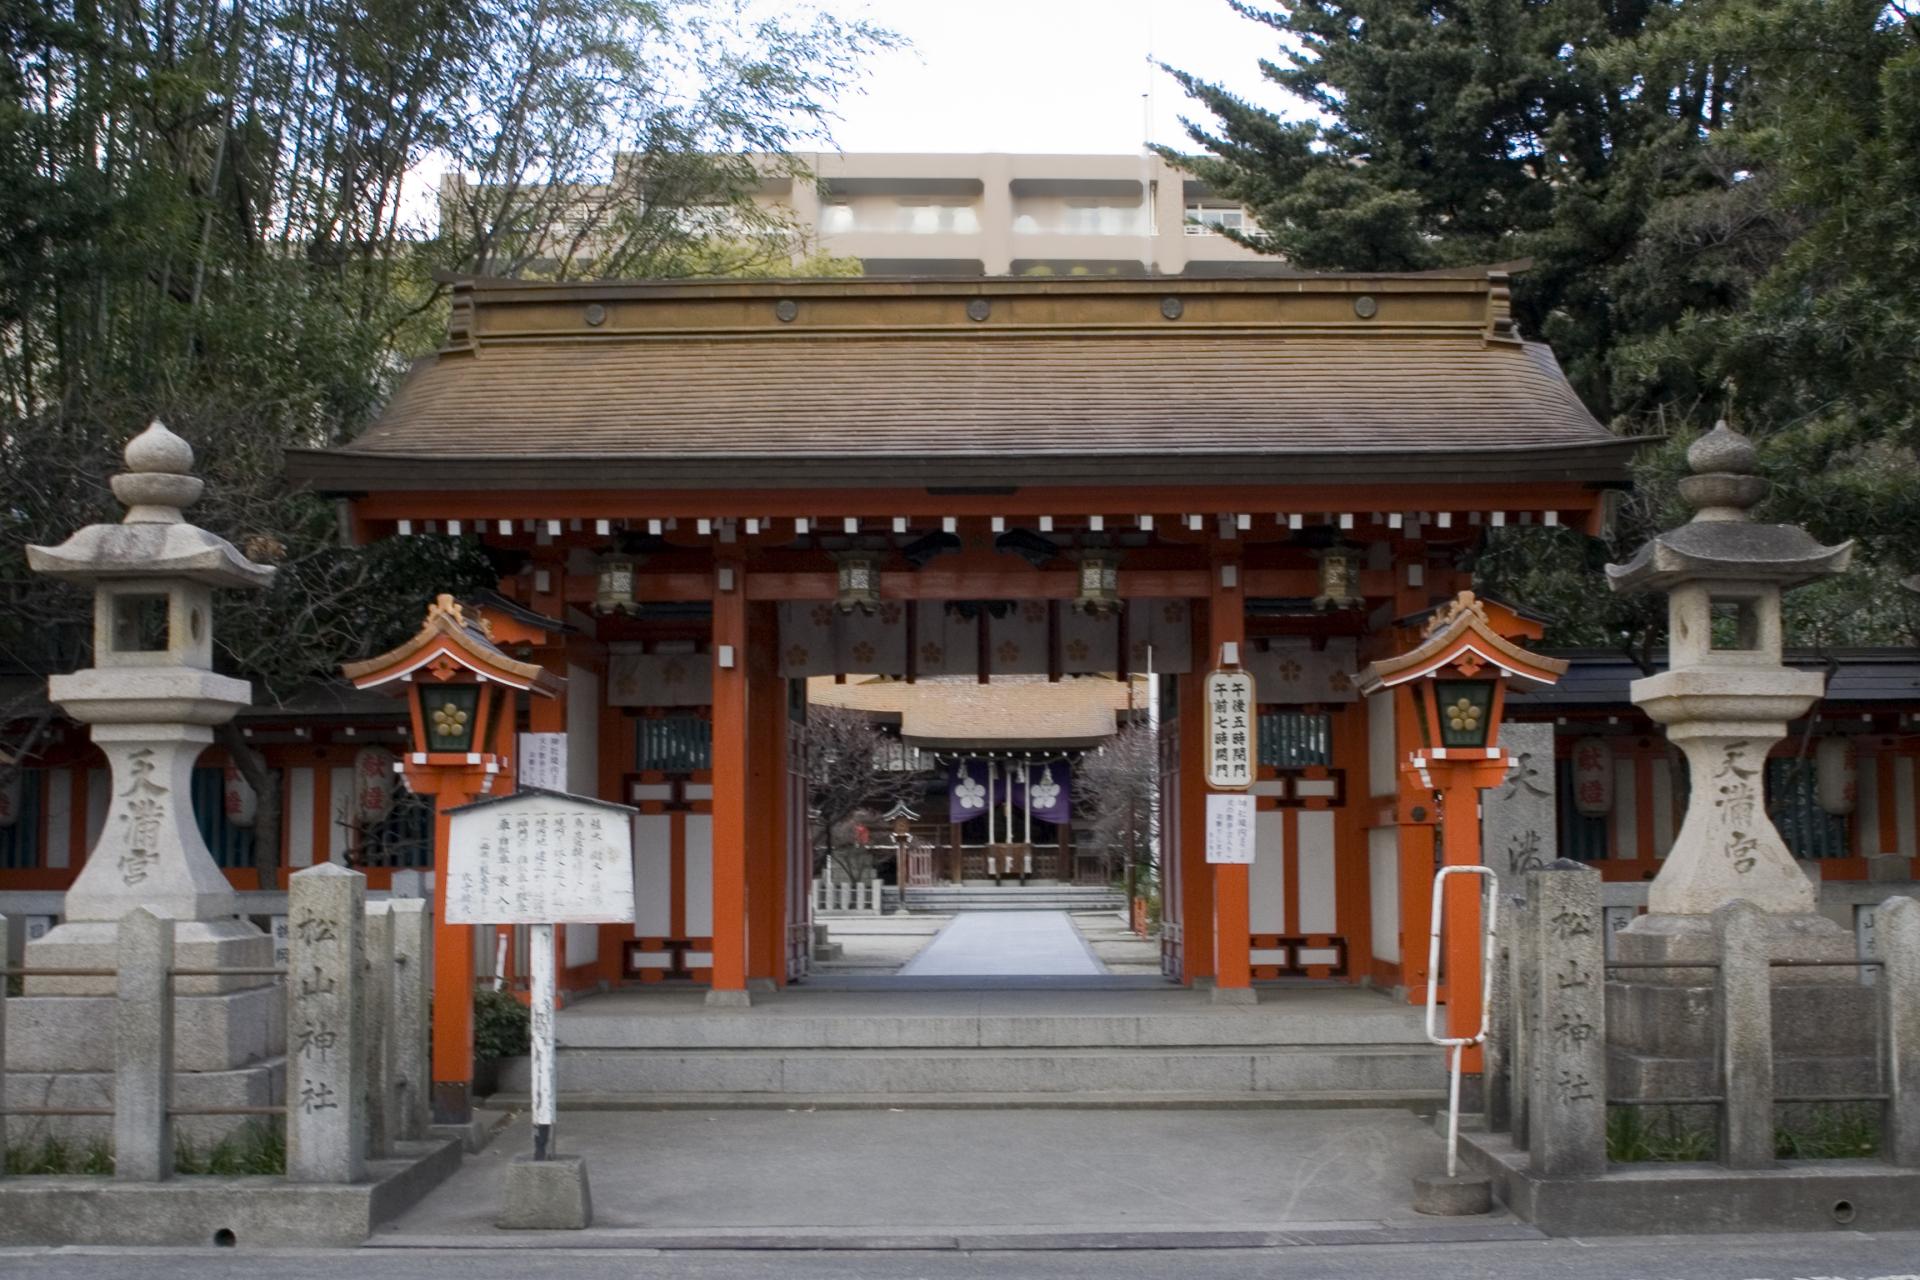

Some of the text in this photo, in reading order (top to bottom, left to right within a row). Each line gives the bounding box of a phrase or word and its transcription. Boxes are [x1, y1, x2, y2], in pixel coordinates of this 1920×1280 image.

[1214, 682, 1229, 778] 午前七時開門
[1232, 682, 1247, 778] 午後五時閉門
[298, 907, 339, 1115] 松山神社
[1551, 905, 1595, 1106] 松山神社
